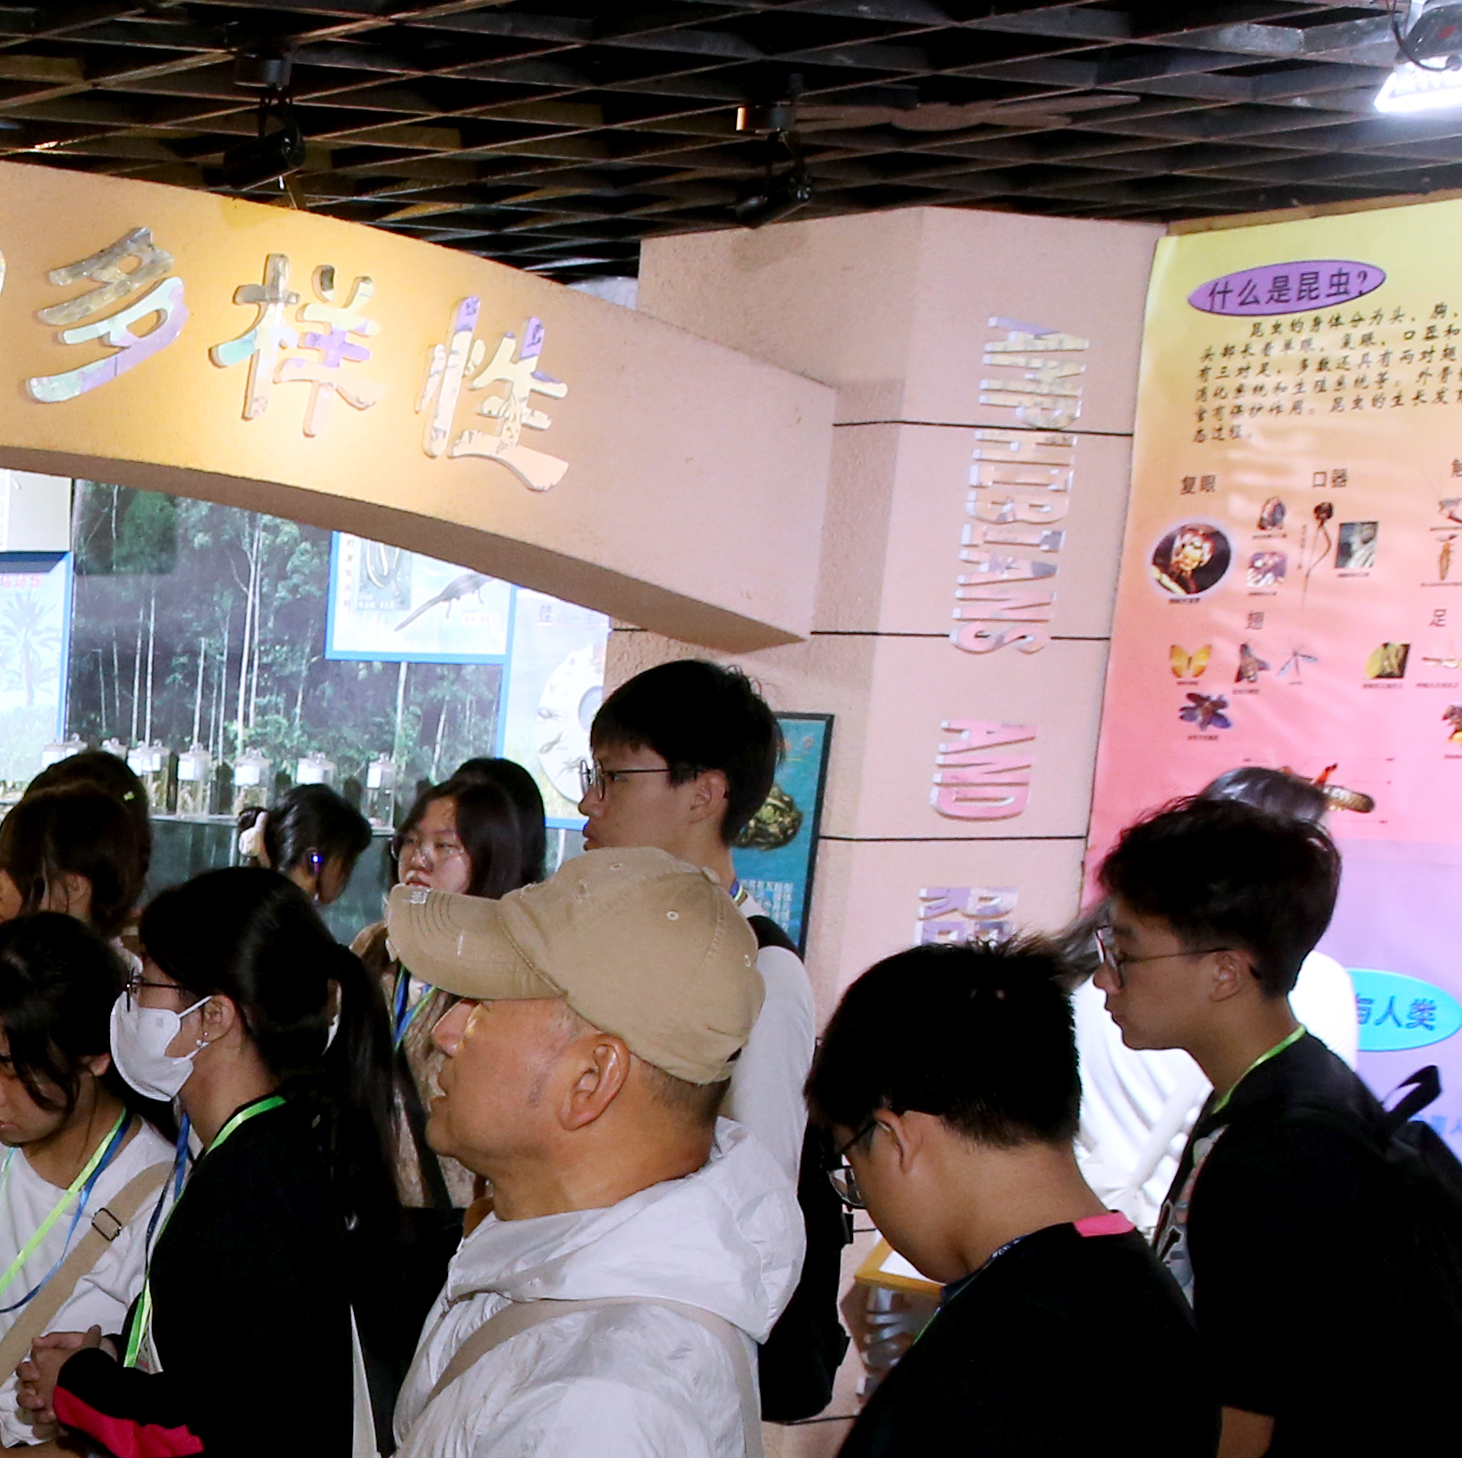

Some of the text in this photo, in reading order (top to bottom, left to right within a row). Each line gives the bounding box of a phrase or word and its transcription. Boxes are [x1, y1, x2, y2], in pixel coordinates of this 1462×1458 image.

[949, 315, 1089, 655] AMPHIBIANS
[1180, 475, 1217, 495] 复眼
[1312, 468, 1348, 489] 口器
[929, 718, 1042, 822] AND
